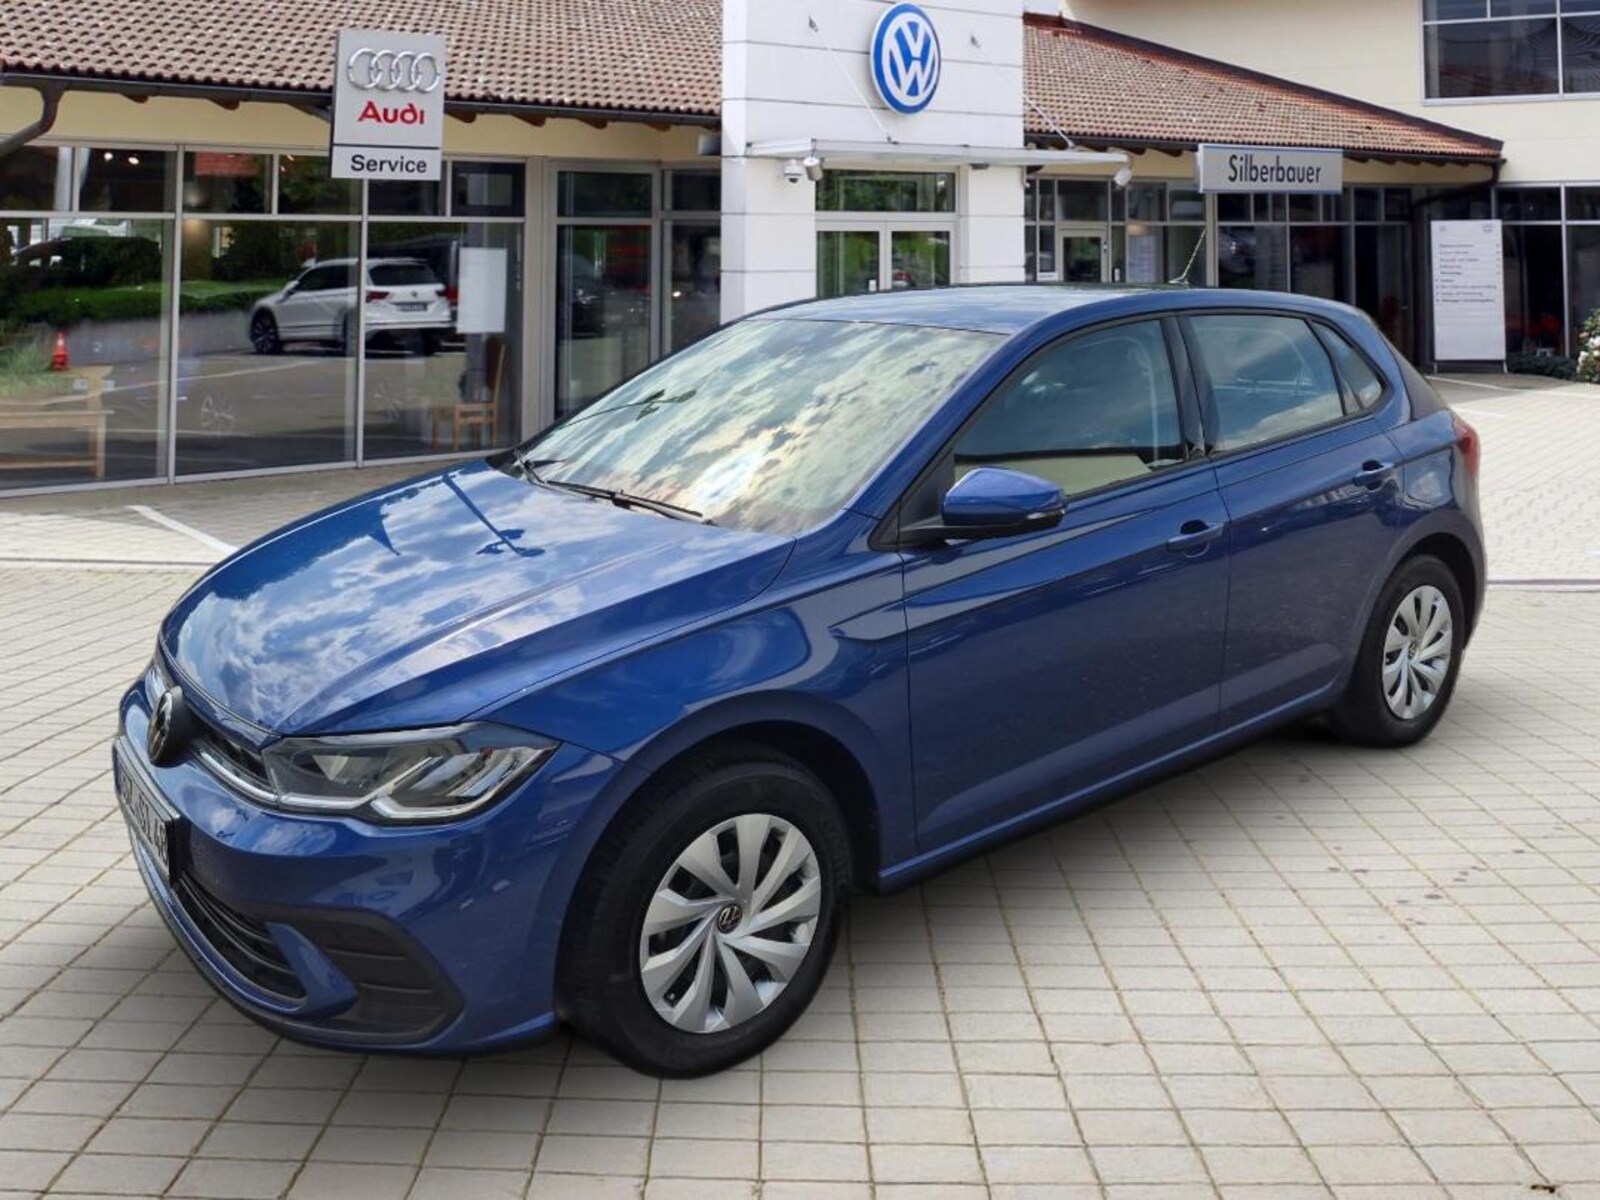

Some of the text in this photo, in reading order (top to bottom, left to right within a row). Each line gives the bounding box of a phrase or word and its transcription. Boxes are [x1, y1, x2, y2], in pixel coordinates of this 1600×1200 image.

[879, 8, 939, 108] VW
[357, 100, 425, 125] Audi
[350, 154, 427, 174] Service
[1228, 153, 1322, 183] Silberbauer
